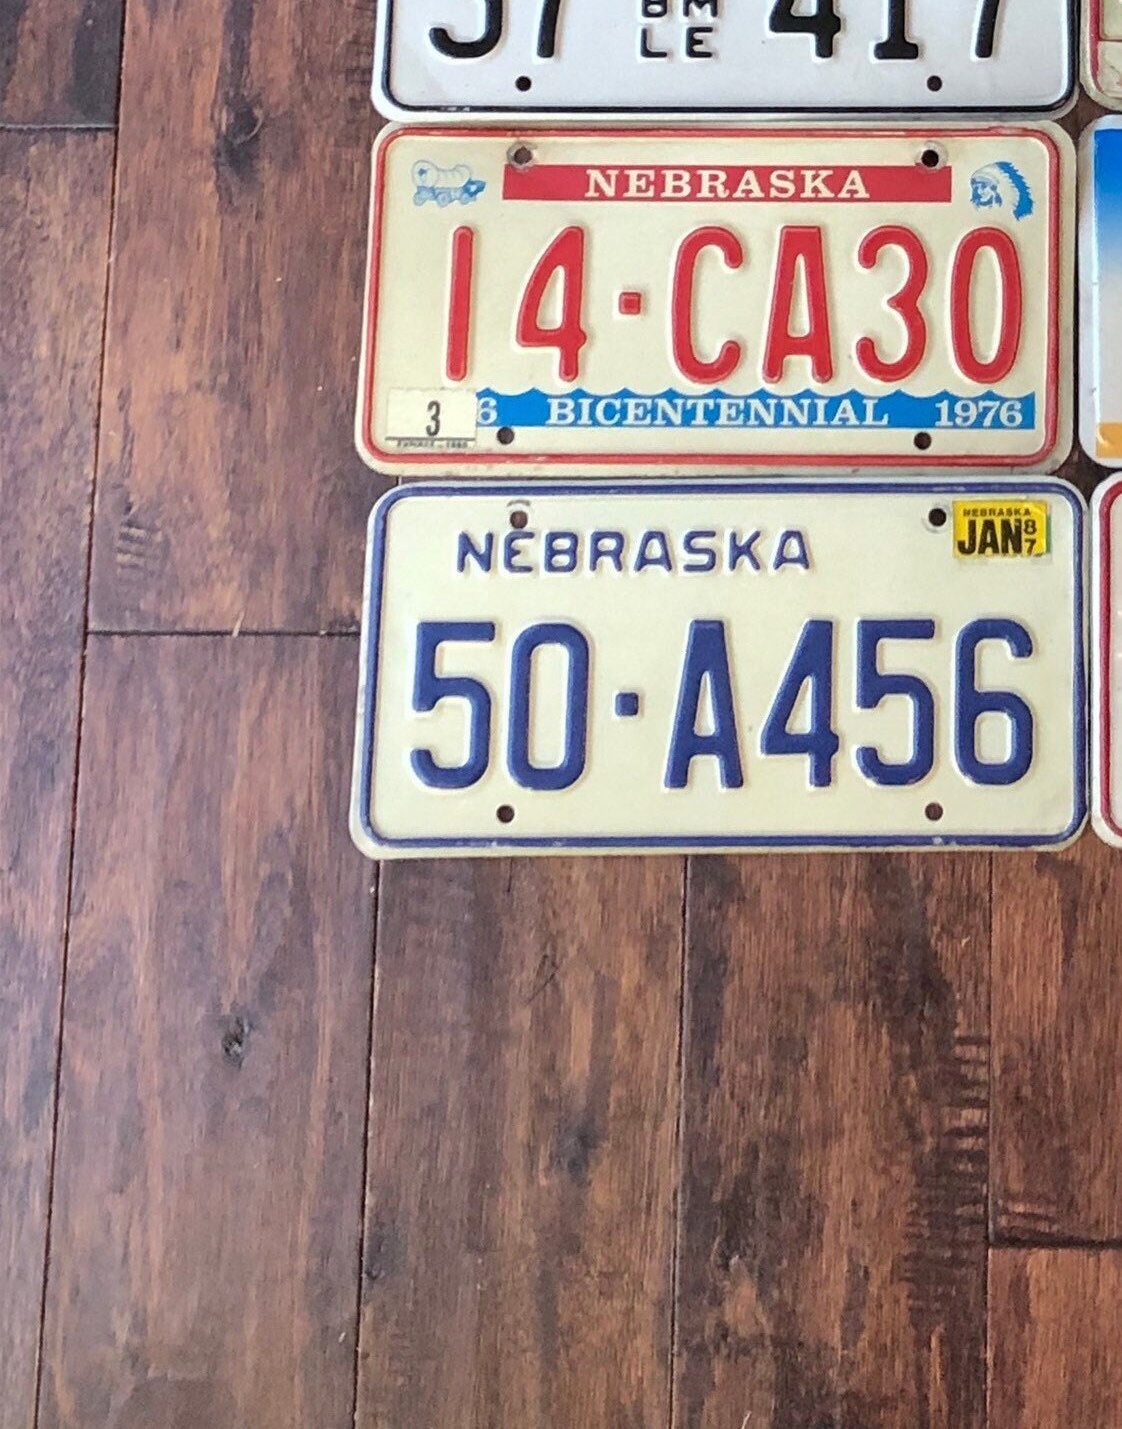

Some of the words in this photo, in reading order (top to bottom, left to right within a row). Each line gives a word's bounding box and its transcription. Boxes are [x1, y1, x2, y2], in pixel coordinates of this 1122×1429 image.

[584, 170, 870, 198] NEBRASKA
[426, 400, 440, 436] 3
[547, 398, 889, 426] BICENTENNIAL
[934, 400, 1022, 425] 1976
[963, 508, 1031, 517] NEBRASKA
[457, 530, 811, 572] NEBRASKA
[958, 519, 1022, 554] JAN
